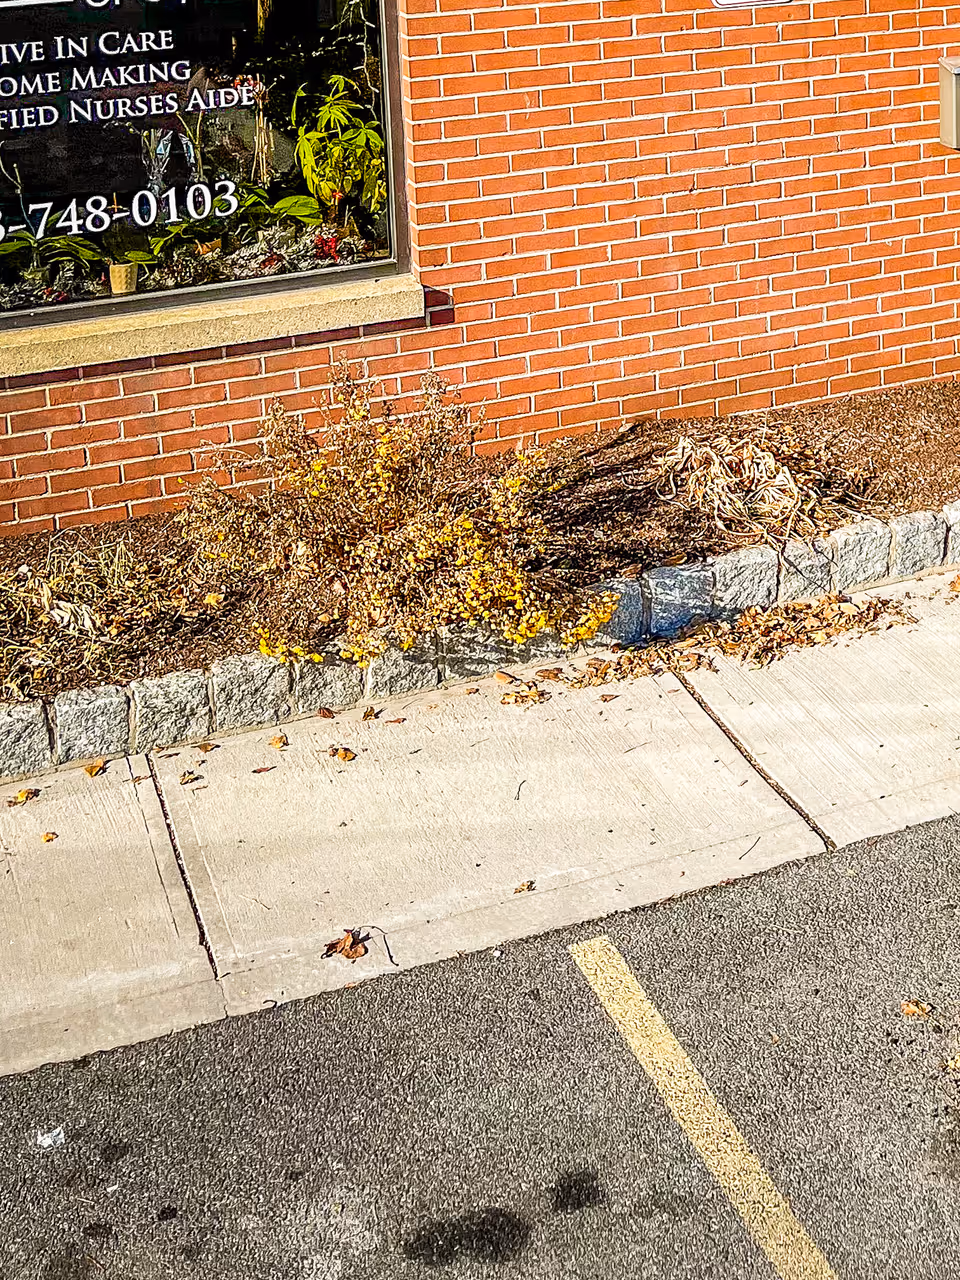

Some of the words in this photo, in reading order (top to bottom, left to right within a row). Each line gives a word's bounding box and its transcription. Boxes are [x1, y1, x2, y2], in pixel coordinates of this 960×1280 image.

[54, 36, 88, 60] IN
[99, 30, 174, 56] CARE
[70, 60, 191, 91] MAKING
[69, 92, 180, 124] NURSES
[186, 86, 256, 113] AIDE
[0, 180, 239, 242] -748-0103
